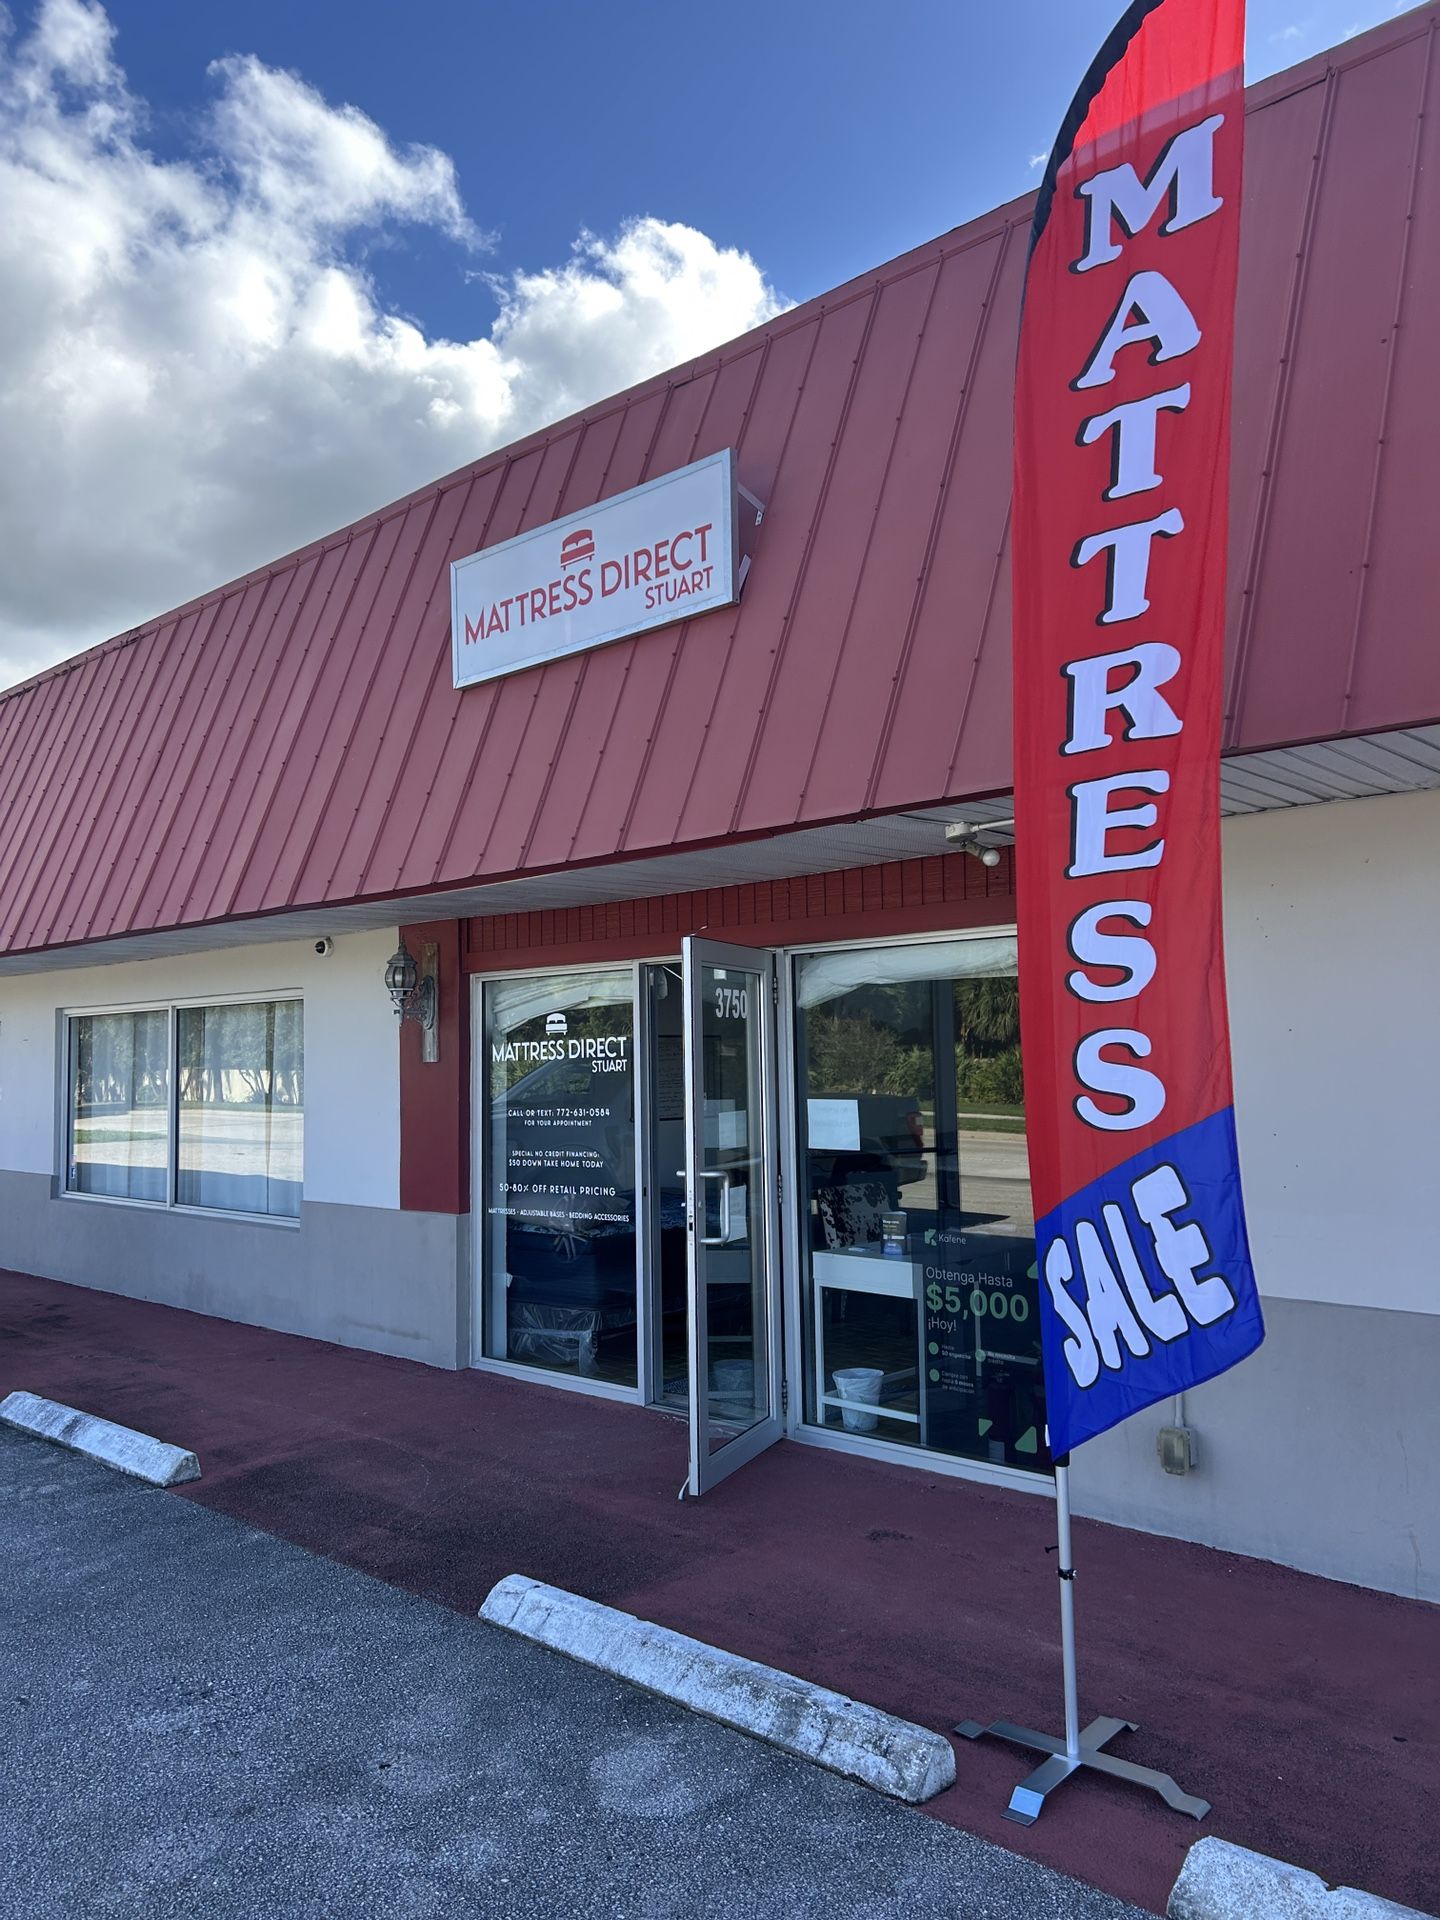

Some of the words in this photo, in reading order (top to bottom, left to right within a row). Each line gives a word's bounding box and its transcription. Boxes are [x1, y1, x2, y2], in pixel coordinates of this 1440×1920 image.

[465, 568, 593, 645] MATTRESS
[600, 523, 713, 598] DIRECT
[645, 565, 714, 610] STUART
[1060, 113, 1225, 1132] MATTRESS
[715, 987, 747, 1019] 3750
[491, 1040, 565, 1062] MATTRESS
[568, 1037, 627, 1059] DIRECT
[591, 1060, 627, 1073] STUART
[508, 1109, 523, 1117] CALL
[525, 1109, 535, 1117] OR
[537, 1109, 554, 1117] TEXT:
[522, 1159, 542, 1167] DOWN
[560, 1160, 580, 1168] HOME
[582, 1160, 604, 1168] TODAY
[499, 1183, 529, 1193] 50-80%
[531, 1184, 547, 1194] OFF
[549, 1185, 577, 1195] RETAIL
[579, 1186, 616, 1197] PRICING
[519, 1209, 549, 1217] ADJUSTABLE
[569, 1211, 593, 1220] BEDDING
[594, 1213, 630, 1222] ACCESSORIES
[938, 1233, 967, 1245] Kafene
[926, 1266, 975, 1286] Obtenga
[978, 1272, 1013, 1288] Hasta
[1044, 1162, 1236, 1389] SALE
[926, 1281, 1029, 1322] $5,000
[928, 1317, 957, 1333] ¡Hoy!
